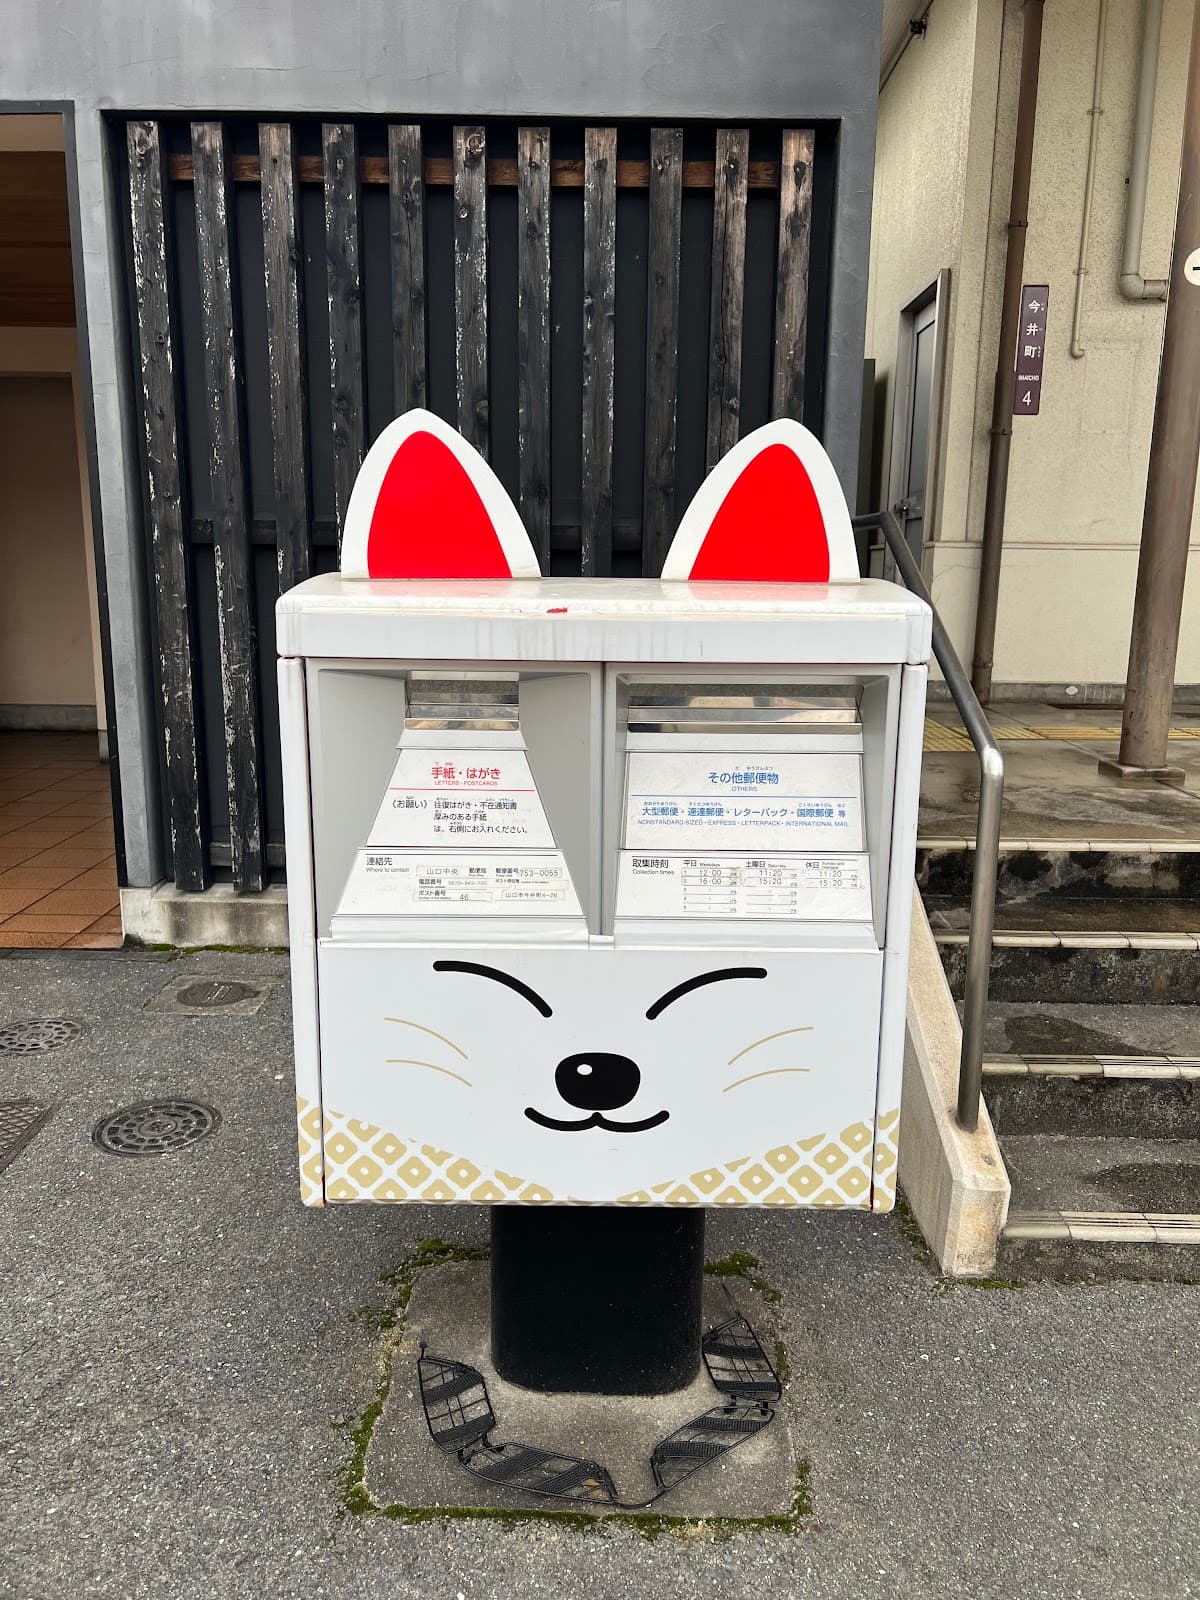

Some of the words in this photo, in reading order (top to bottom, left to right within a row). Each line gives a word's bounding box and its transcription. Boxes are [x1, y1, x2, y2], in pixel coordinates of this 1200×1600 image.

[1024, 300, 1041, 359] 今井町
[1022, 390, 1032, 406] 4
[431, 767, 502, 780] 手紙・はがき
[708, 772, 780, 785] その他郵便物
[433, 813, 488, 822] 厚みのある手紙
[433, 825, 529, 835] は、右側にお入れください。
[366, 856, 393, 866] 連絡先
[632, 859, 669, 868] 取集時刻
[745, 860, 766, 868] 土曜日
[805, 861, 820, 869] 休日
[426, 867, 459, 875] 山口中央
[519, 869, 559, 877] 753-0055
[699, 869, 722, 877] 12:00
[759, 869, 783, 877] 11:20
[759, 878, 783, 886] 15:20
